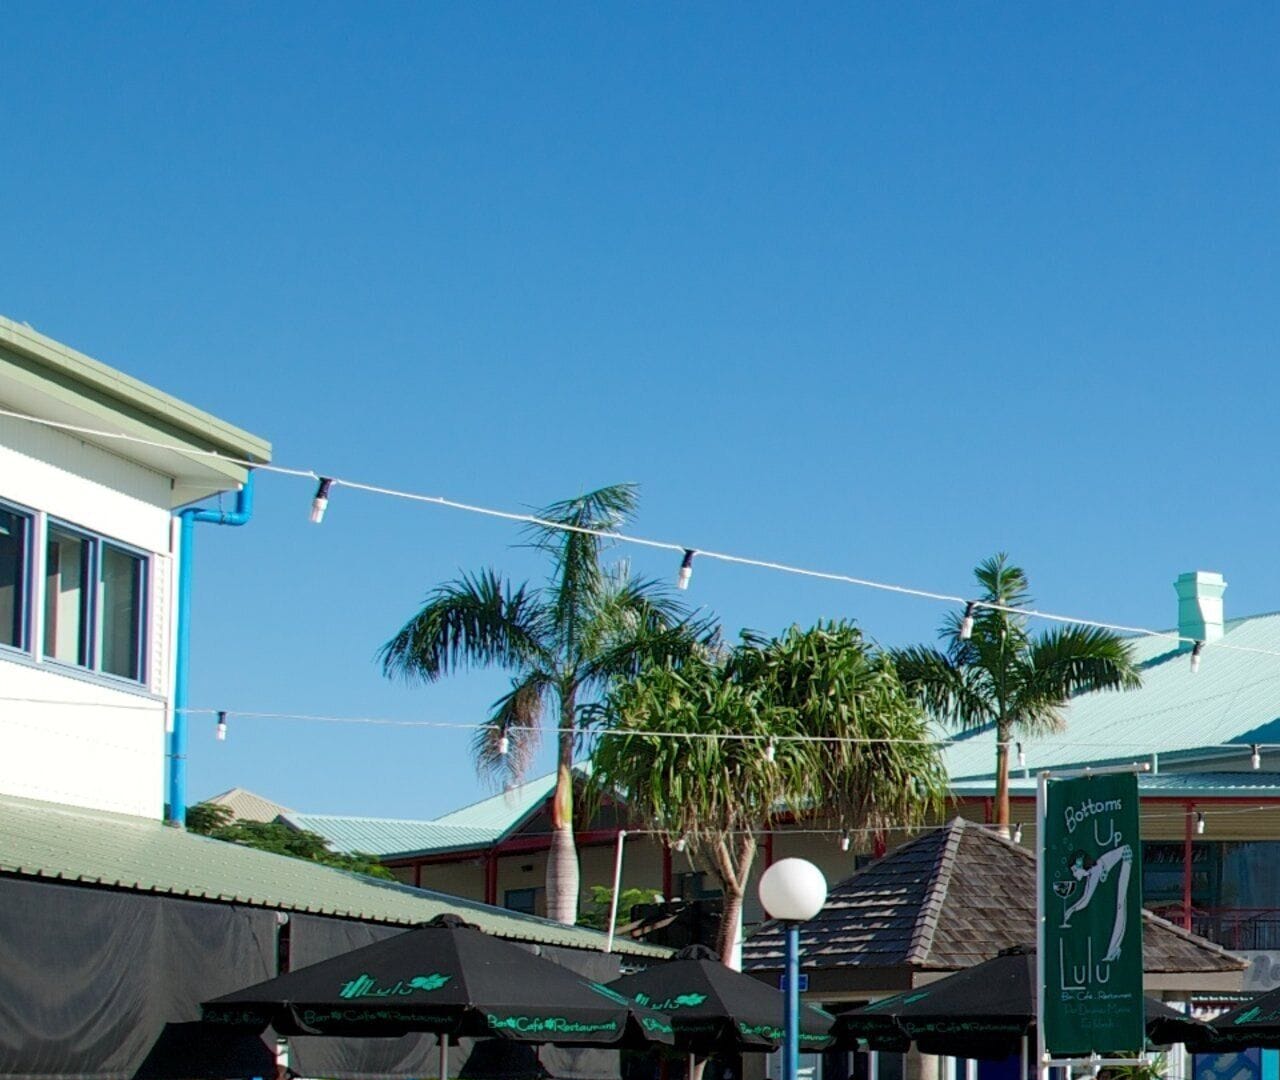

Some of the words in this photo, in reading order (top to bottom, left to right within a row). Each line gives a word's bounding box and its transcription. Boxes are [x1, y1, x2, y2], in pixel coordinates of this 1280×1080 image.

[1064, 798, 1123, 834] Bottoms
[1094, 819, 1122, 847] Up
[1059, 936, 1111, 991] Lulu
